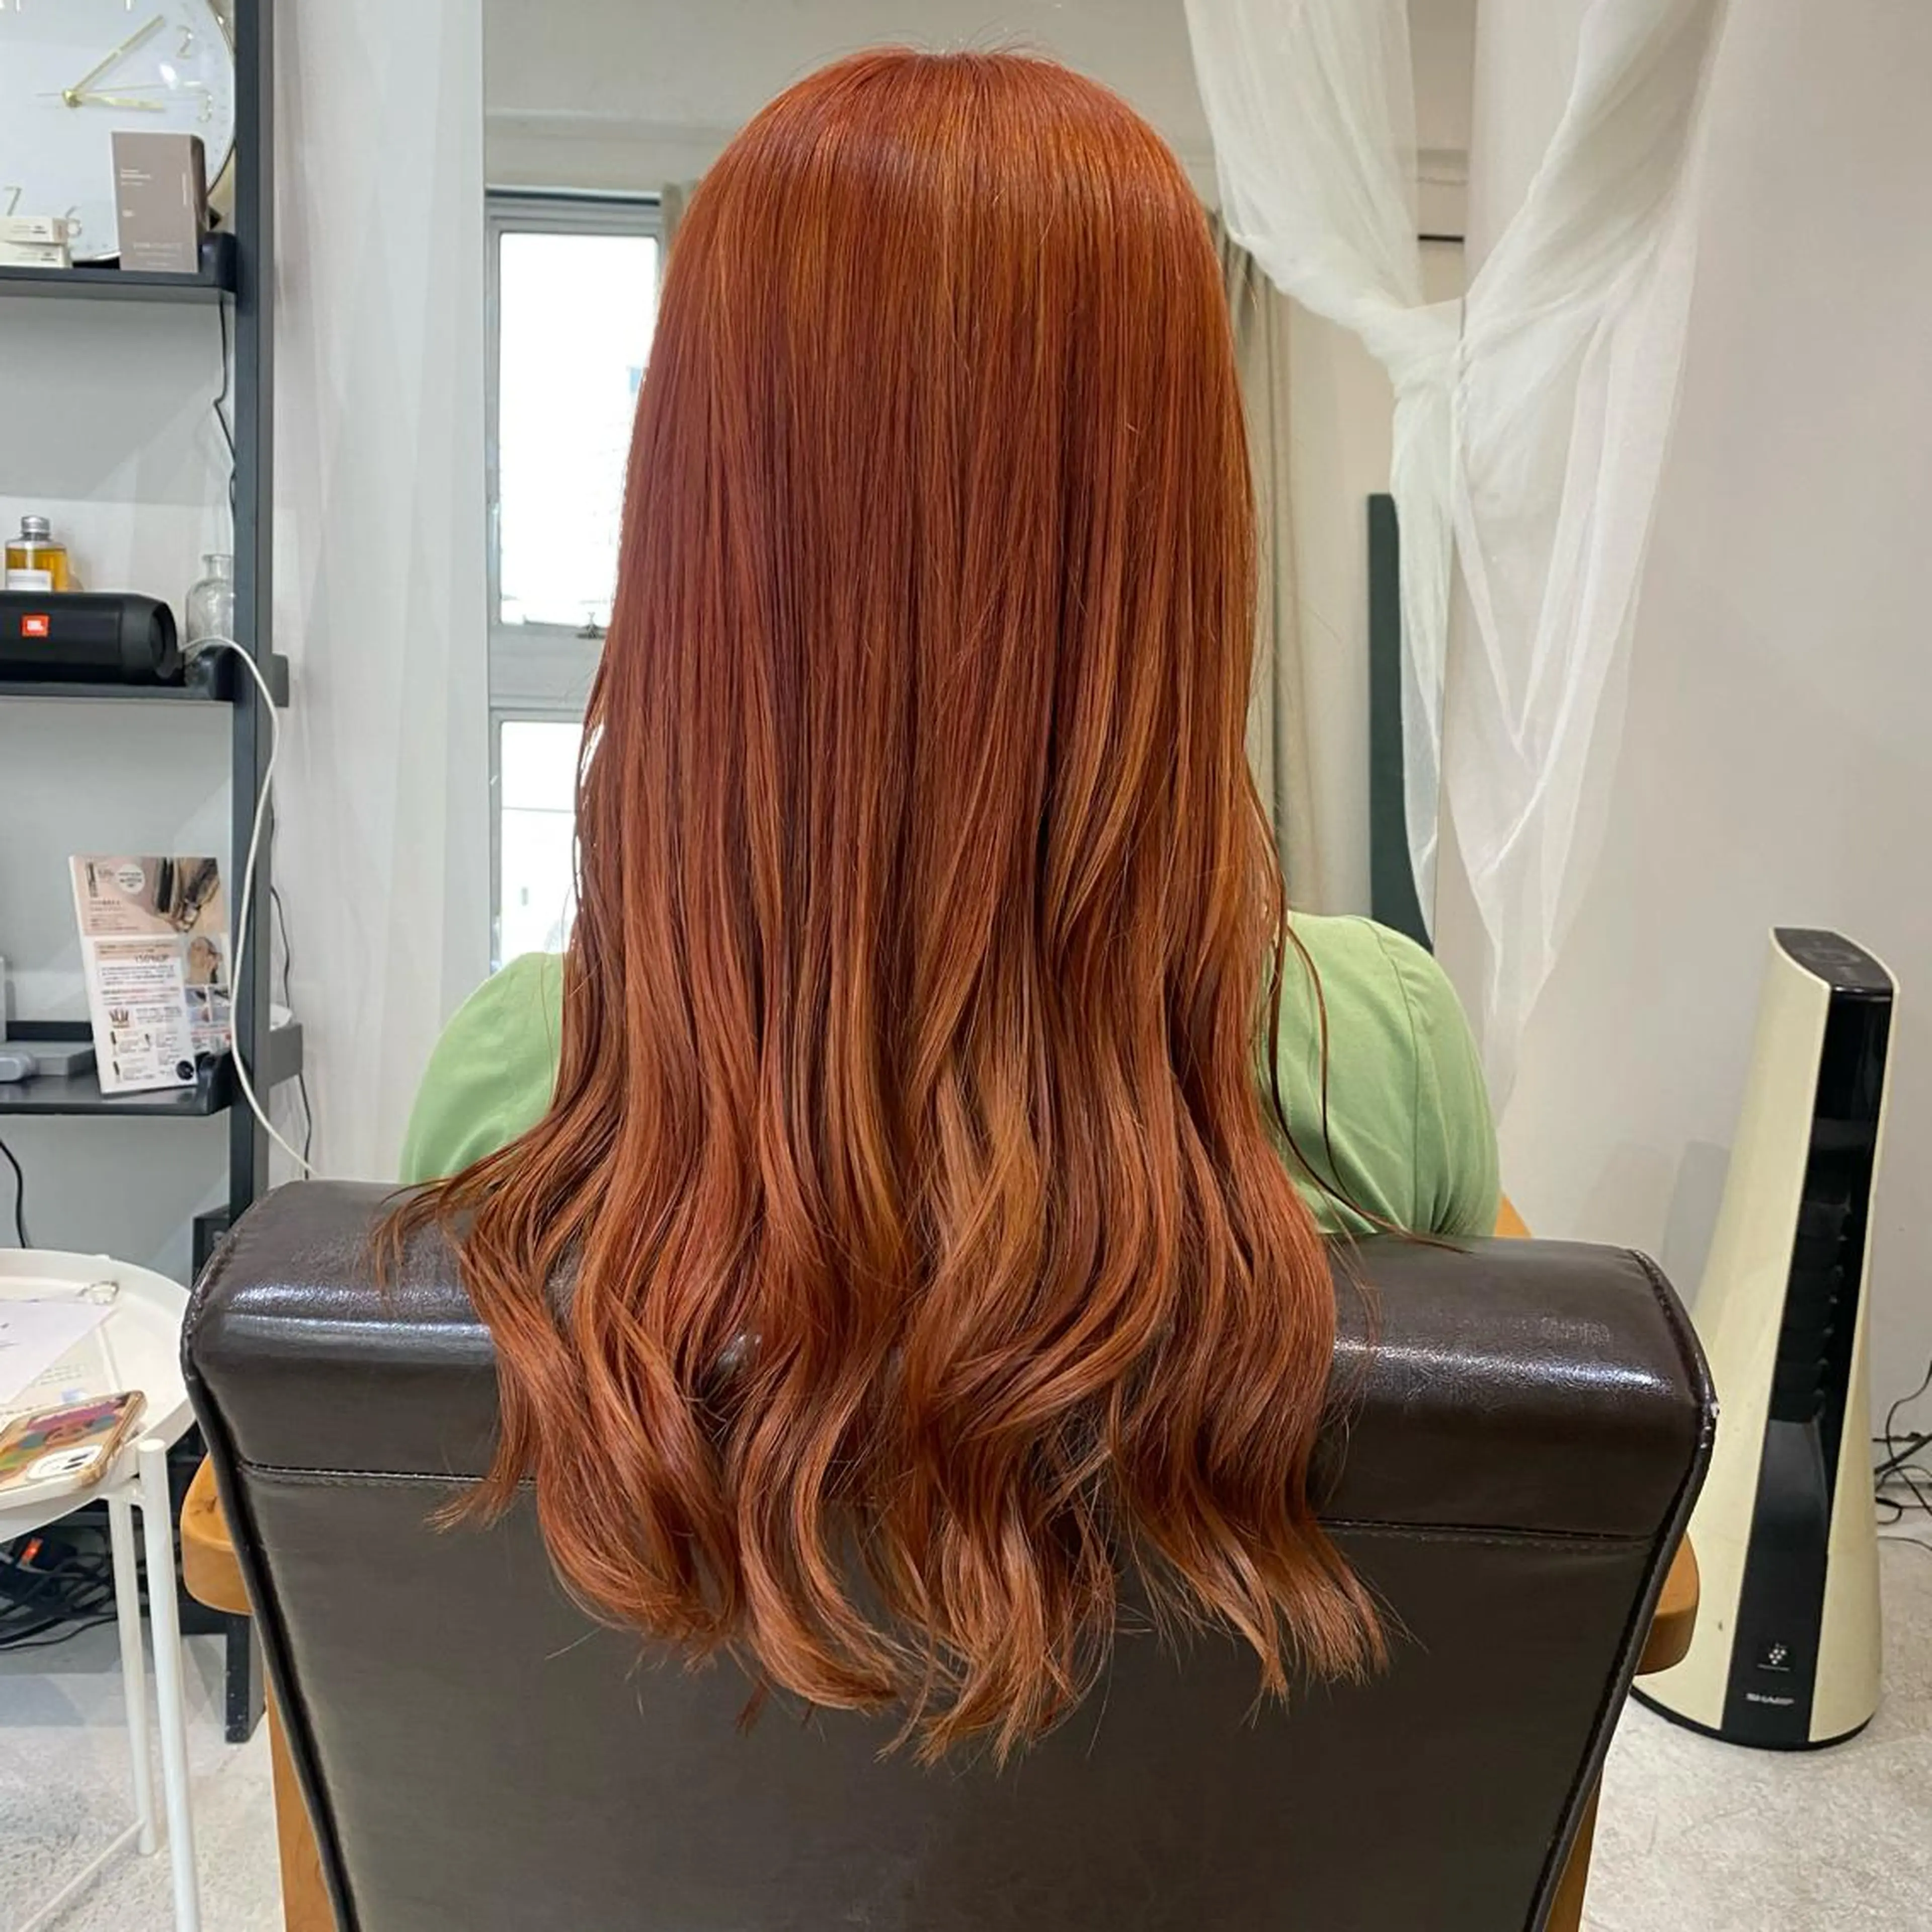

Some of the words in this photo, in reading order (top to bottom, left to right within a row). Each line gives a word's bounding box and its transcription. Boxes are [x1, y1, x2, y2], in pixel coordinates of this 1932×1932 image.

[176, 25, 193, 59] 2
[196, 89, 213, 120] 3
[4, 186, 22, 216] 7
[65, 205, 82, 238] 6
